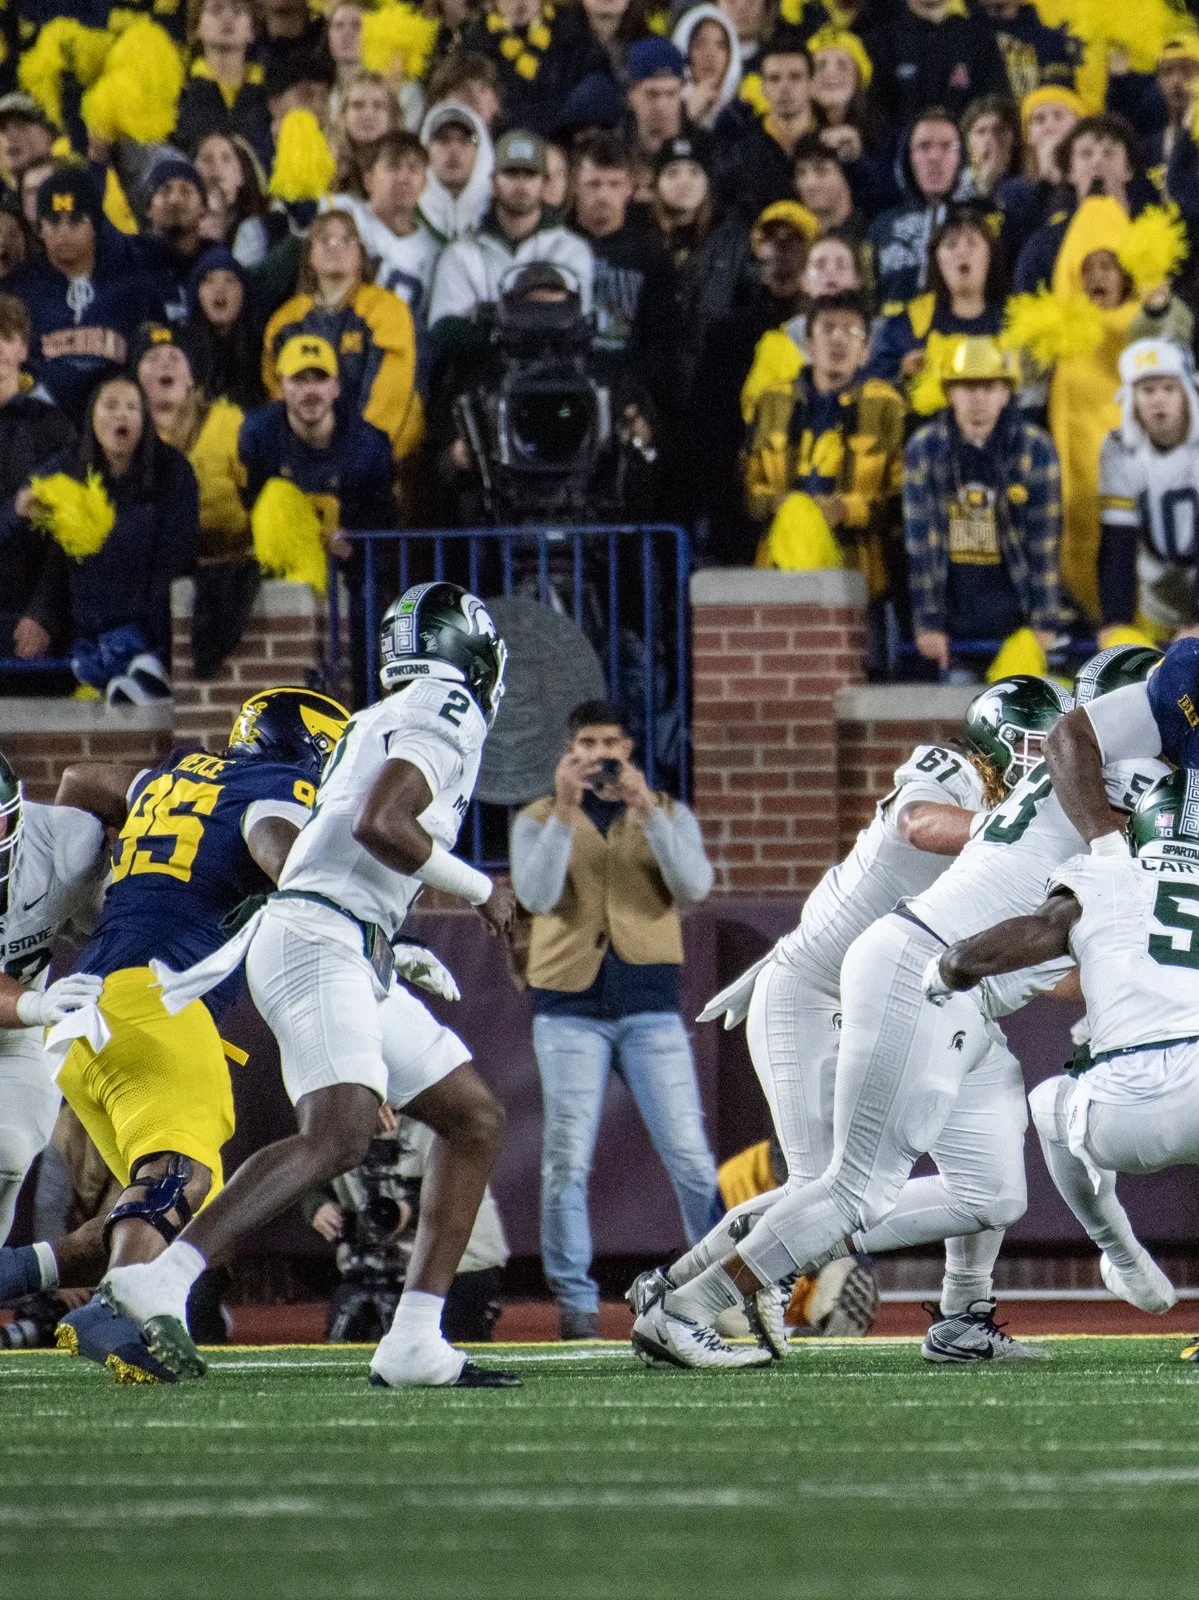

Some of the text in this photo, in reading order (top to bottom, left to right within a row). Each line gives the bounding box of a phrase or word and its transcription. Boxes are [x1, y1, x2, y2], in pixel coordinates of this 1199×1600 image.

[385, 664, 430, 678] SPARTANS
[438, 690, 470, 728] 2
[915, 748, 962, 783] 67
[111, 773, 225, 883] 95
[8, 926, 53, 954] STATE
